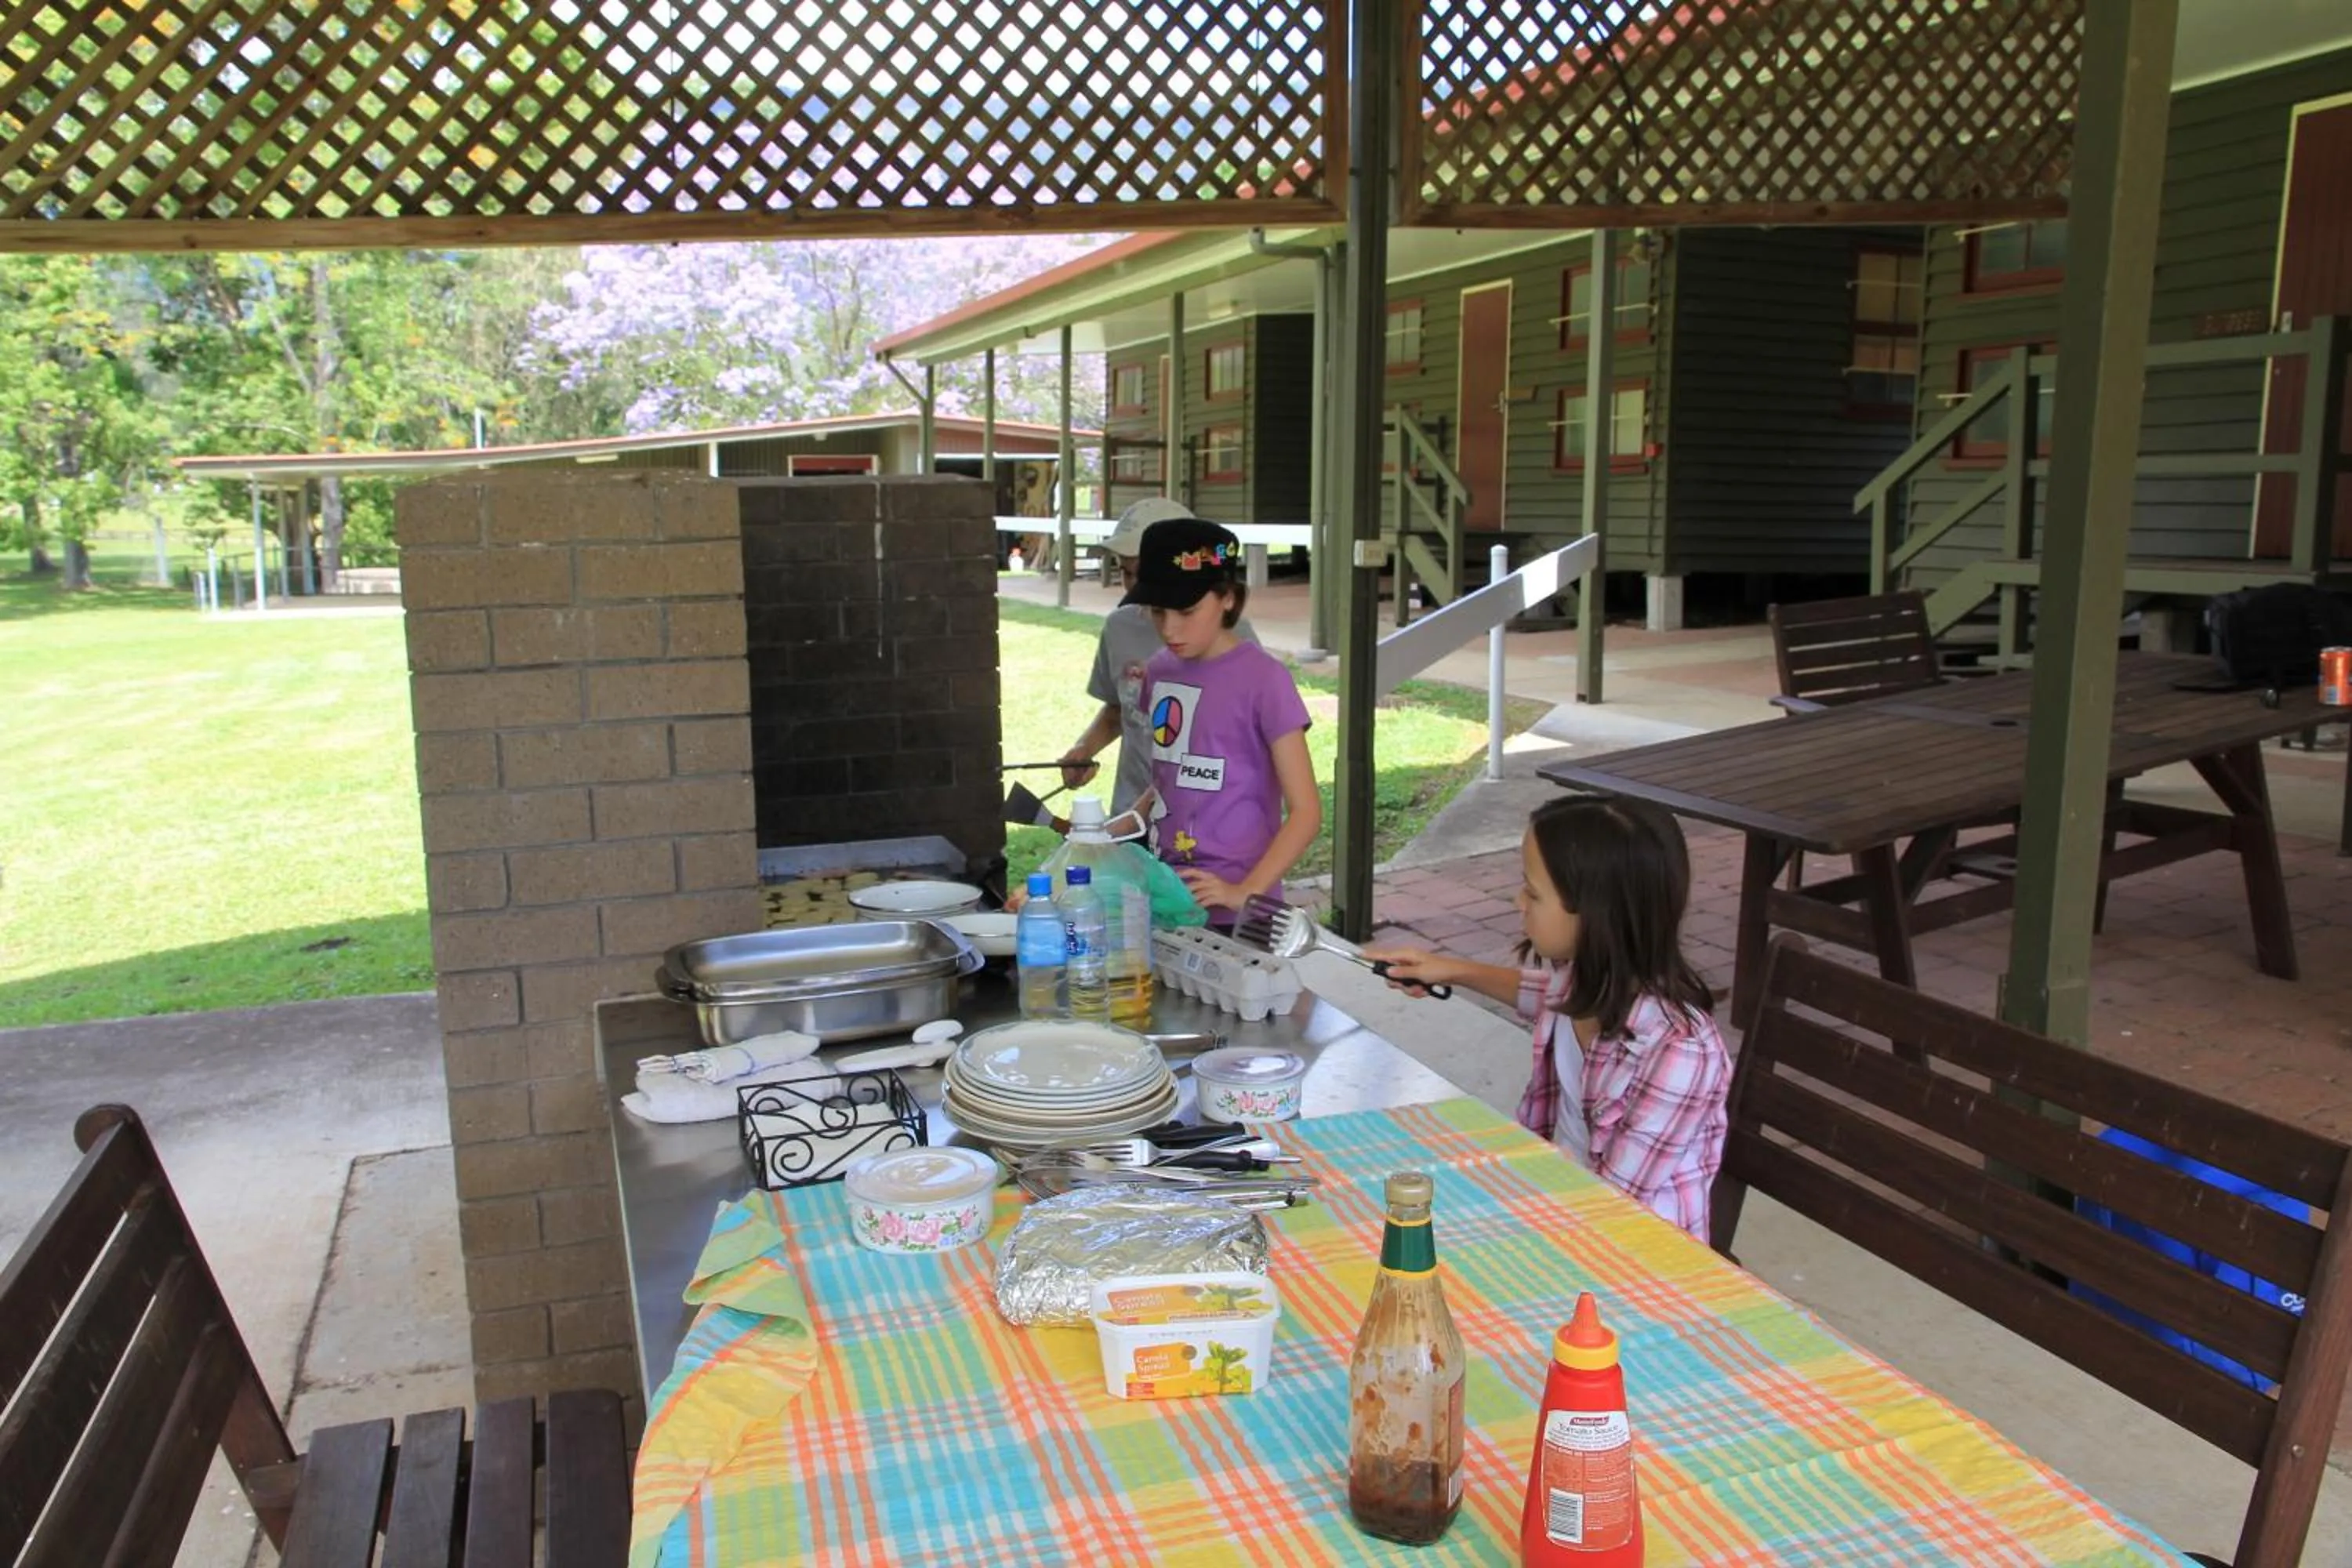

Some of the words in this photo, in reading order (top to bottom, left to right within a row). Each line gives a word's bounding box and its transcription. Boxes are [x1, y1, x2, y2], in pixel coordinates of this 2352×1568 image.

[1180, 765, 1220, 781] PEACE
[1137, 1353, 1169, 1364] Canola
[1138, 1362, 1171, 1374] Spread
[1559, 1422, 1592, 1434] Tomato
[1594, 1424, 1619, 1434] Sauce
